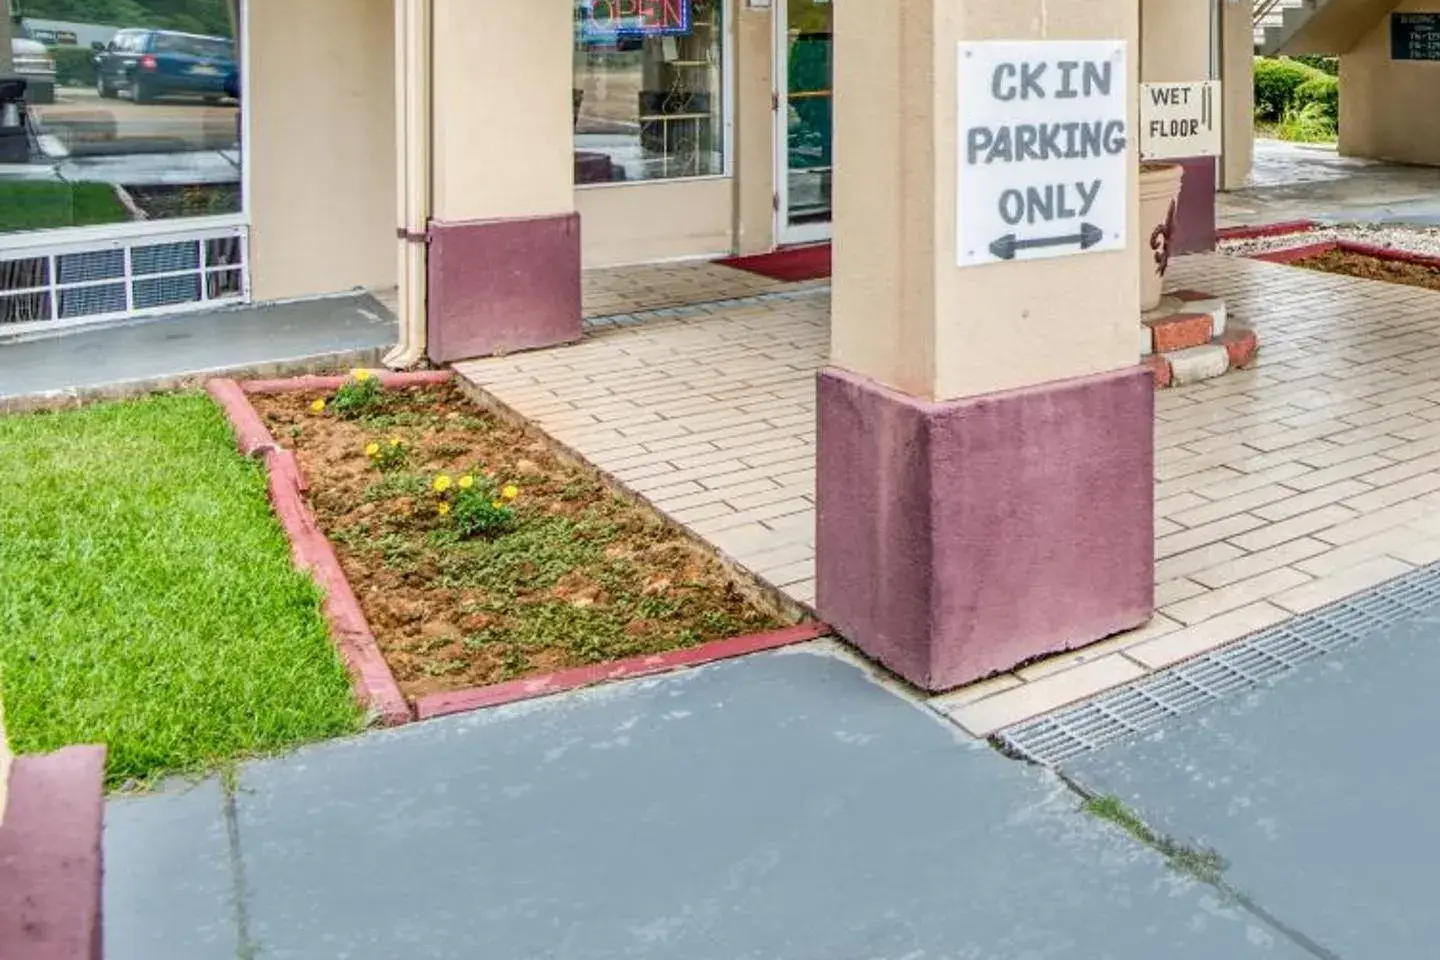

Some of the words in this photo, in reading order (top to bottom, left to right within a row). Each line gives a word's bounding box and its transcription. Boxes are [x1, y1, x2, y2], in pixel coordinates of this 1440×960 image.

[1150, 87, 1191, 106] WET
[967, 120, 1127, 165] PARKING
[1149, 118, 1200, 138] FLOOR
[998, 179, 1102, 225] ONLY
